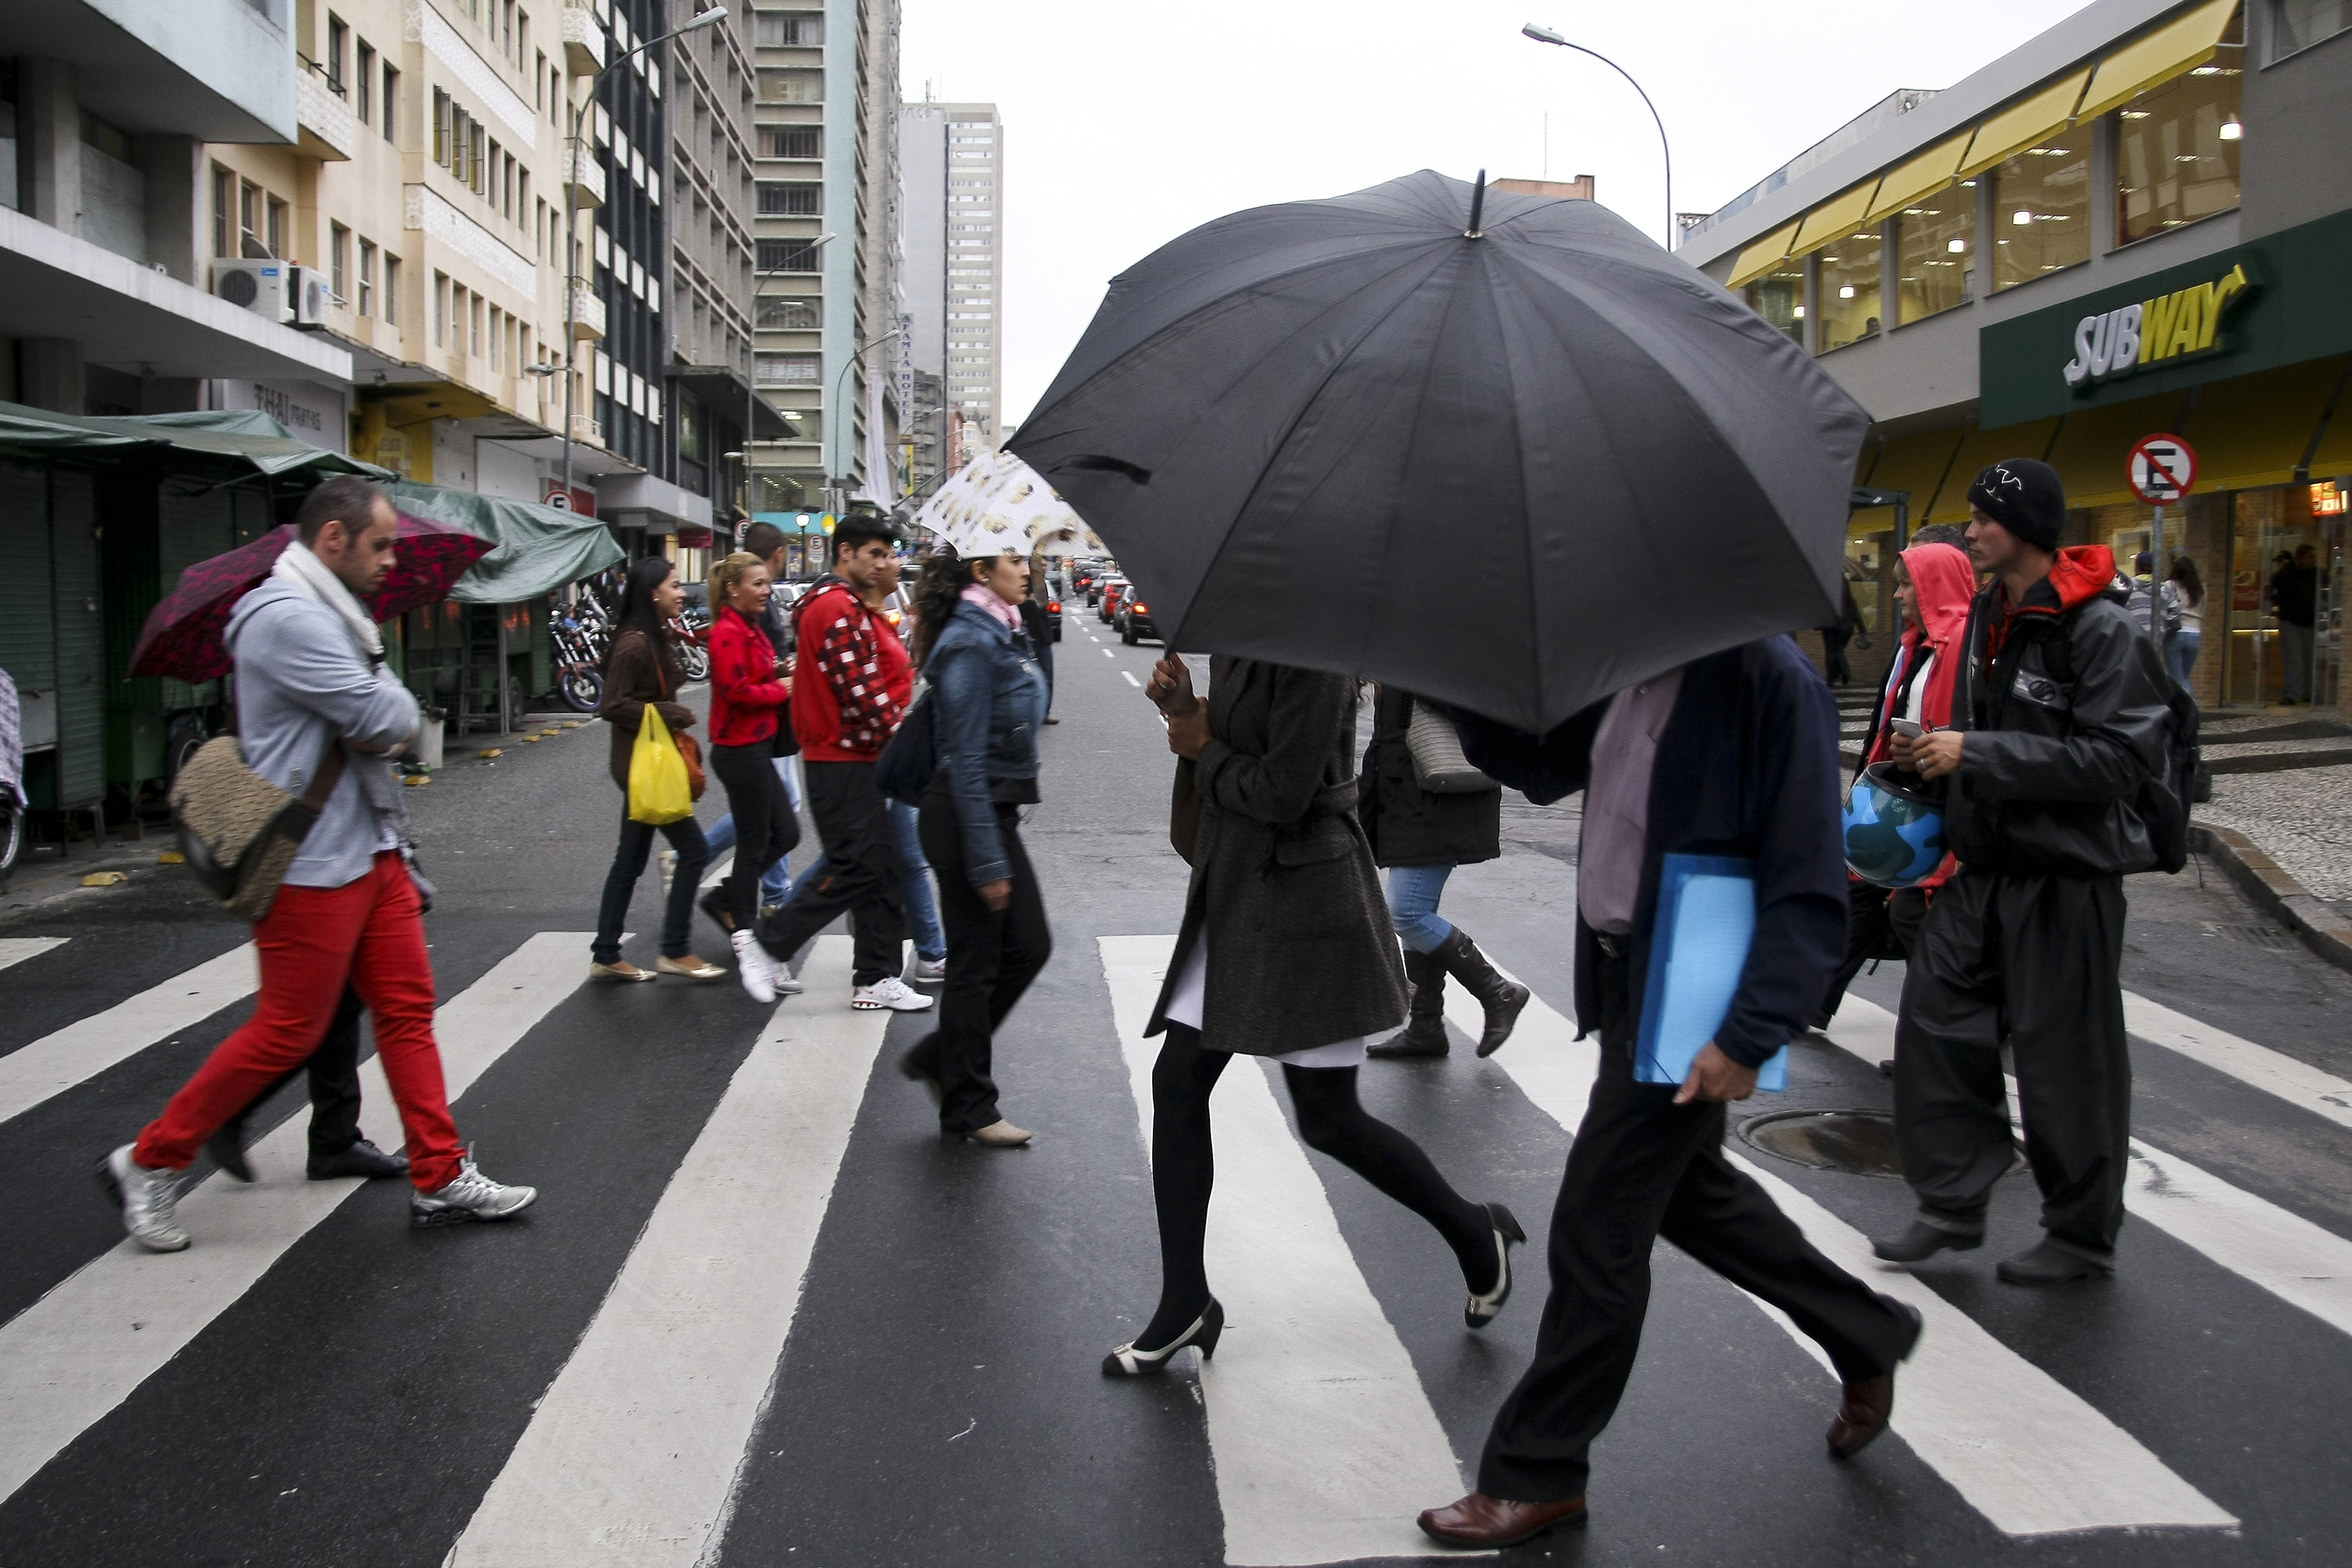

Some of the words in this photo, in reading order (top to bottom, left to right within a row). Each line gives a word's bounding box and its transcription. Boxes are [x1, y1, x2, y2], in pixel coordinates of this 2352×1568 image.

[2063, 264, 2247, 386] SUBWAY
[254, 383, 289, 426] THAI
[901, 373, 911, 416] HOTEL
